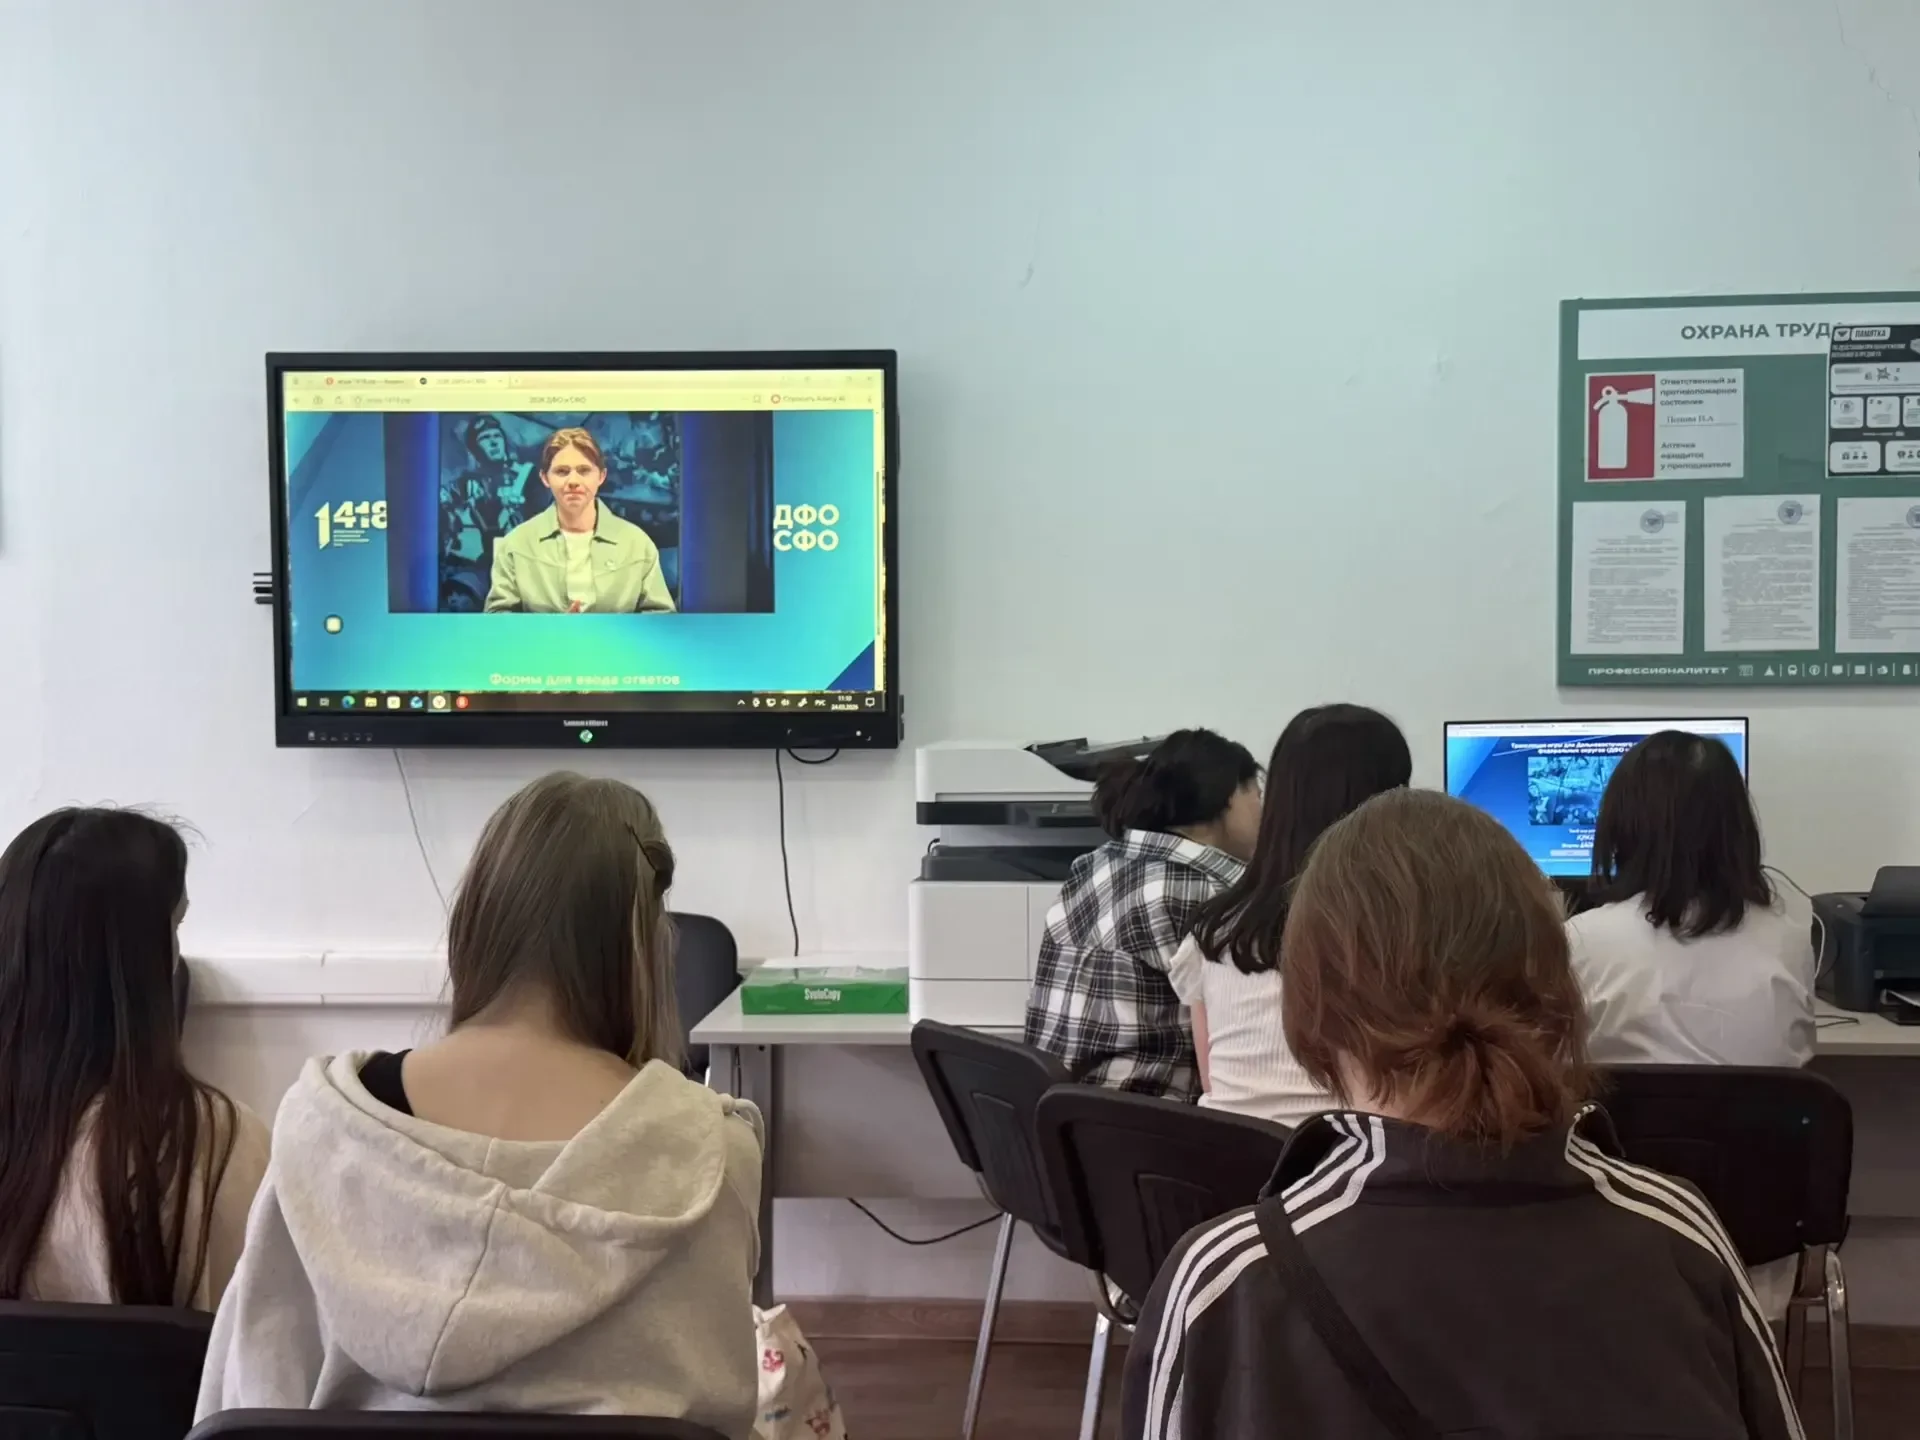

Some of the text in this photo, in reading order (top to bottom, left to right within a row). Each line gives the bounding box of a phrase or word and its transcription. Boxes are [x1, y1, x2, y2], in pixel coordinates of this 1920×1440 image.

[1681, 322, 1831, 340] ОХРАНА ТРУД
[1854, 329, 1886, 338] ПАМЯТКА
[1660, 377, 1725, 386] Ответственный
[1660, 388, 1737, 397] противопожарное
[1660, 399, 1704, 407] состояние
[1660, 452, 1704, 460] находится
[773, 504, 840, 529] ДФО
[773, 529, 839, 551] СФО
[1588, 667, 1729, 675] ПРОФЕССИОНАЛИТЕТ
[490, 673, 681, 686] Формы для ввода ответов
